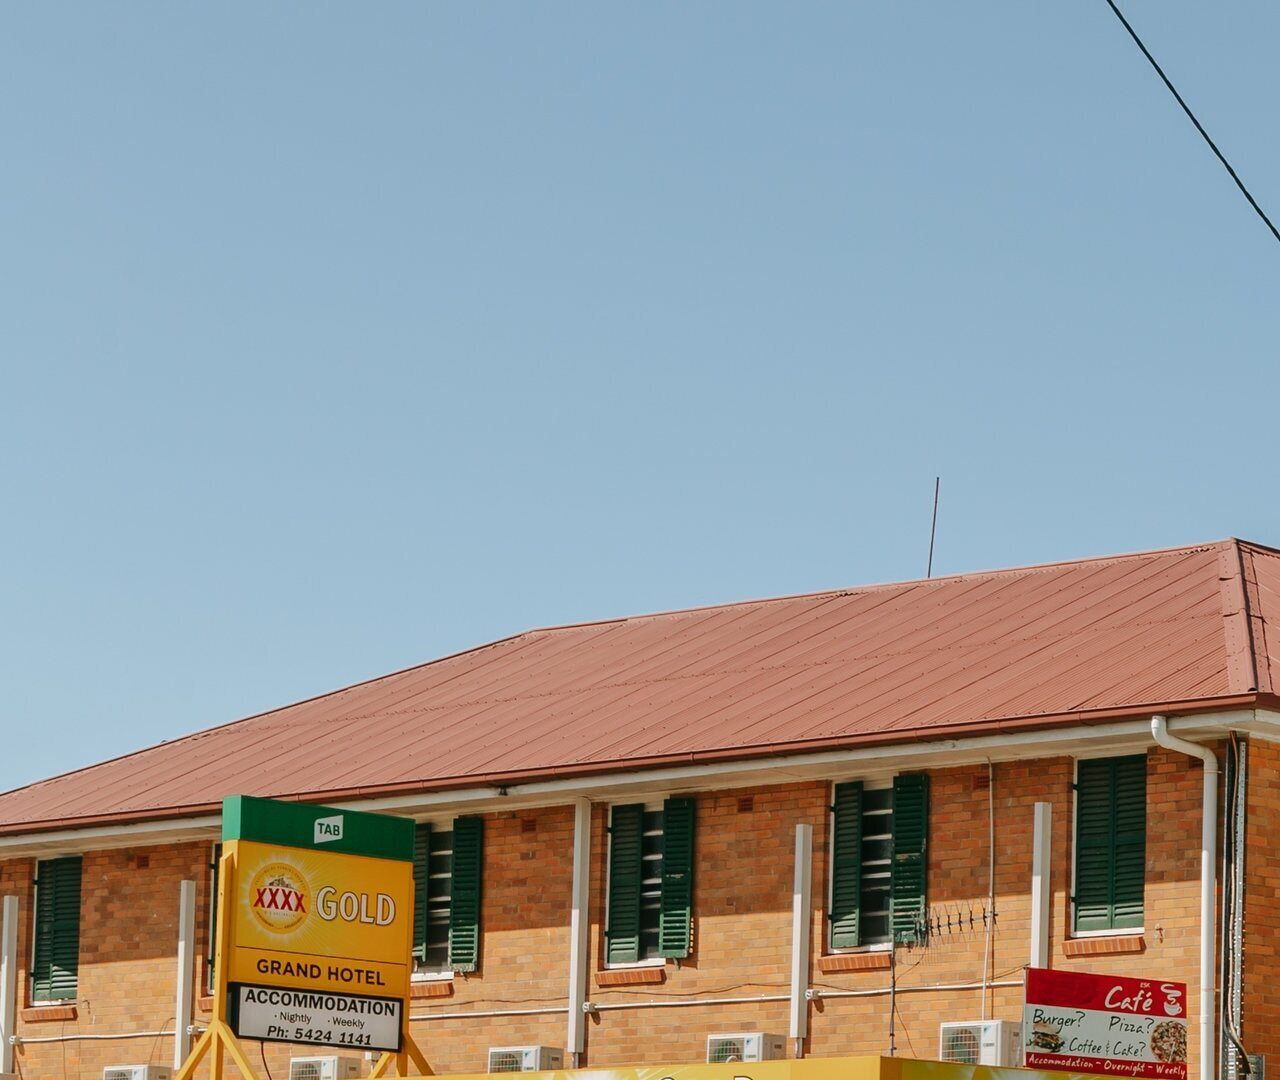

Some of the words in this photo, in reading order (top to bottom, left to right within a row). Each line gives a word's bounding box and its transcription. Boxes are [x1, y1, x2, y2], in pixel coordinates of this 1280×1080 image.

[317, 822, 340, 836] TAB
[253, 888, 306, 913] XXXX
[316, 885, 396, 926] GOLD
[257, 958, 321, 979] GRAND
[328, 967, 385, 986] HOTEL
[245, 989, 395, 1016] ACCOMMODATION
[1104, 985, 1153, 1012] Café
[280, 1012, 312, 1025] Nightly
[333, 1017, 365, 1030] Weekly
[1033, 1009, 1085, 1034] Burger?
[1108, 1016, 1155, 1034] Pizza?
[267, 1025, 288, 1038] Ph:
[294, 1028, 332, 1041] 5424
[339, 1032, 371, 1045] 1141
[1069, 1037, 1102, 1055] Coffee
[1113, 1040, 1147, 1057] Cake?
[1029, 1054, 1094, 1068] Accommodation
[1104, 1061, 1145, 1076] Overnight
[1156, 1063, 1186, 1078] Weekly
